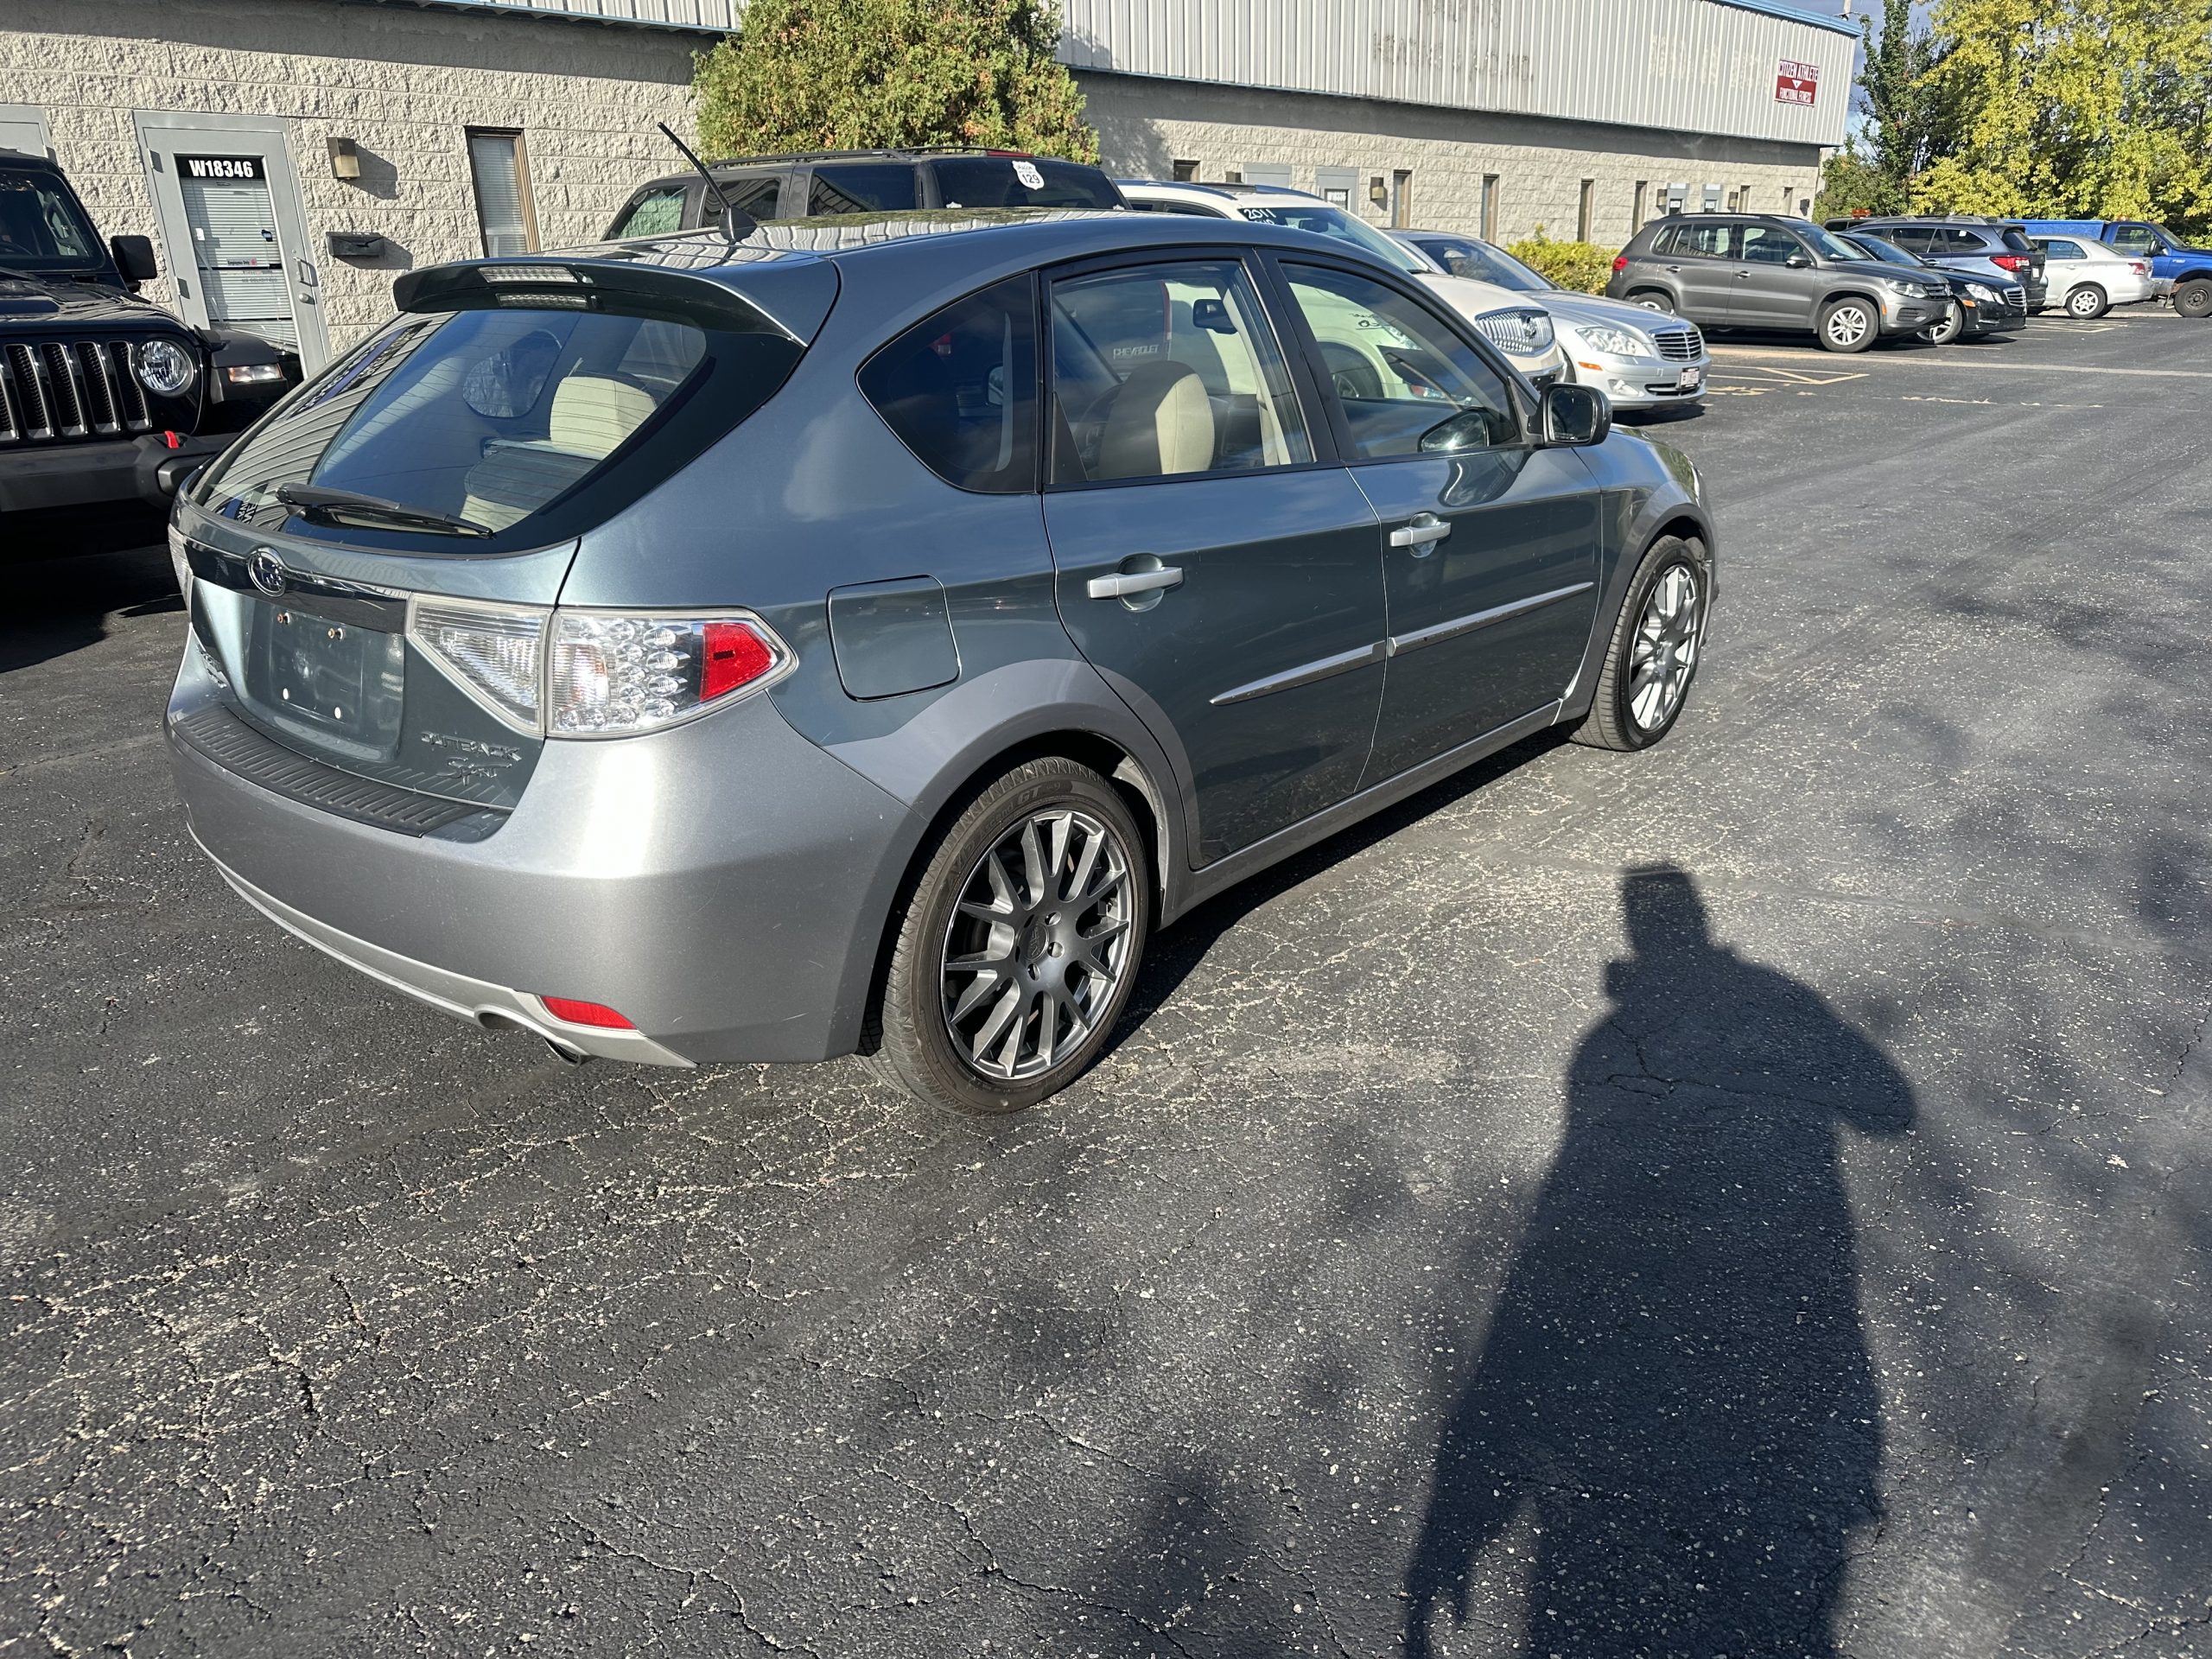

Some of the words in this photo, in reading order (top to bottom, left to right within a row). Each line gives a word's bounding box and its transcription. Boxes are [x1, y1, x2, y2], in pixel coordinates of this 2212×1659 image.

[1778, 60, 1798, 79] CITIZEN
[1797, 63, 1819, 83] ATHLETE
[1779, 87, 1798, 101] FUNCTIONAL
[1798, 90, 1812, 103] FITNESS
[188, 159, 254, 178] W18346
[1021, 174, 1040, 184] 129
[1243, 208, 1277, 219] 2011
[421, 731, 522, 761] OUTBACK
[1018, 785, 1042, 805] GT
